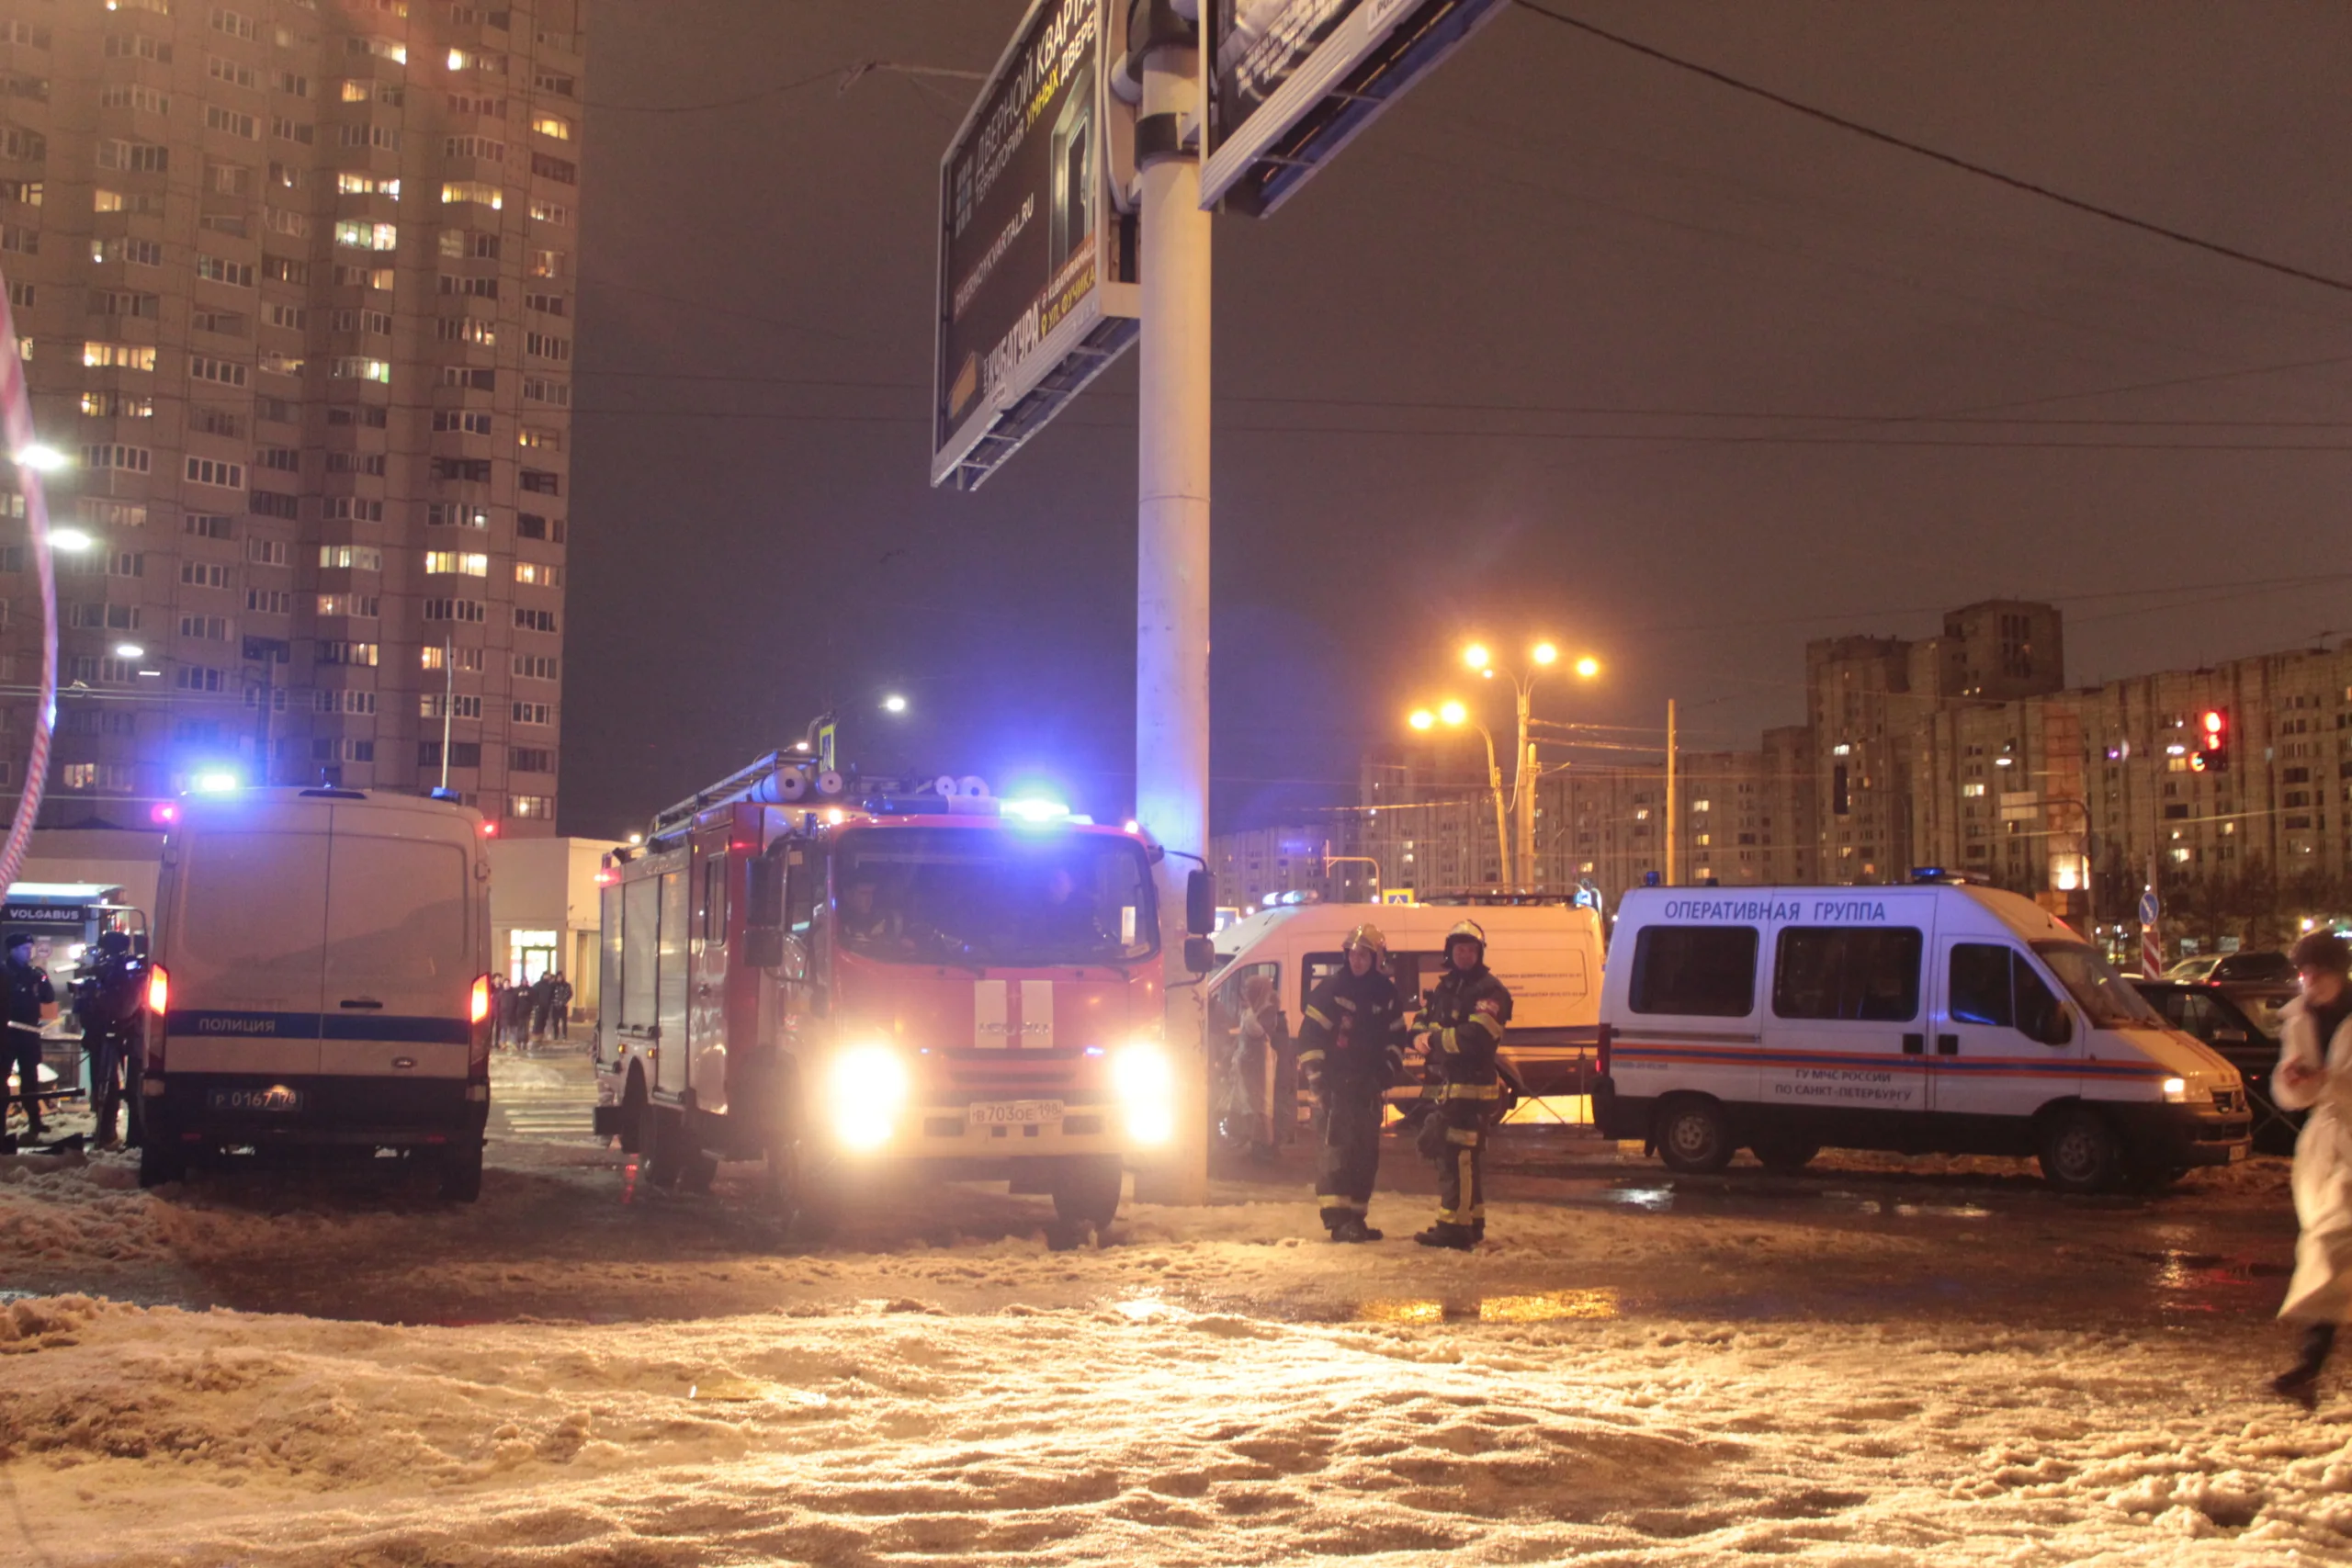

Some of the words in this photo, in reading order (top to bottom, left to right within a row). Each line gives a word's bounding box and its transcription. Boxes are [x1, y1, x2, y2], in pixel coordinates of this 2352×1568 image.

[976, 48, 1032, 182] ДВЕРНОЙ
[975, 118, 1024, 207] ТЕРРИТОРИЯ
[1025, 63, 1059, 131] УМНЫХ
[1061, 265, 1095, 314] ФУЧИКА
[988, 300, 1039, 392] КУБАТУРА
[9, 909, 79, 919] VOLGABUS
[1664, 900, 1801, 920] ОПЕРАТИВНАЯ
[1814, 901, 1885, 921] ГРУППА
[199, 1018, 275, 1032] ПОЛИЦИЯ
[1795, 1069, 1810, 1079] ГУ
[1812, 1070, 1838, 1080] МЧС
[1841, 1071, 1891, 1082] РОССИИ
[1775, 1084, 1792, 1094] ПО
